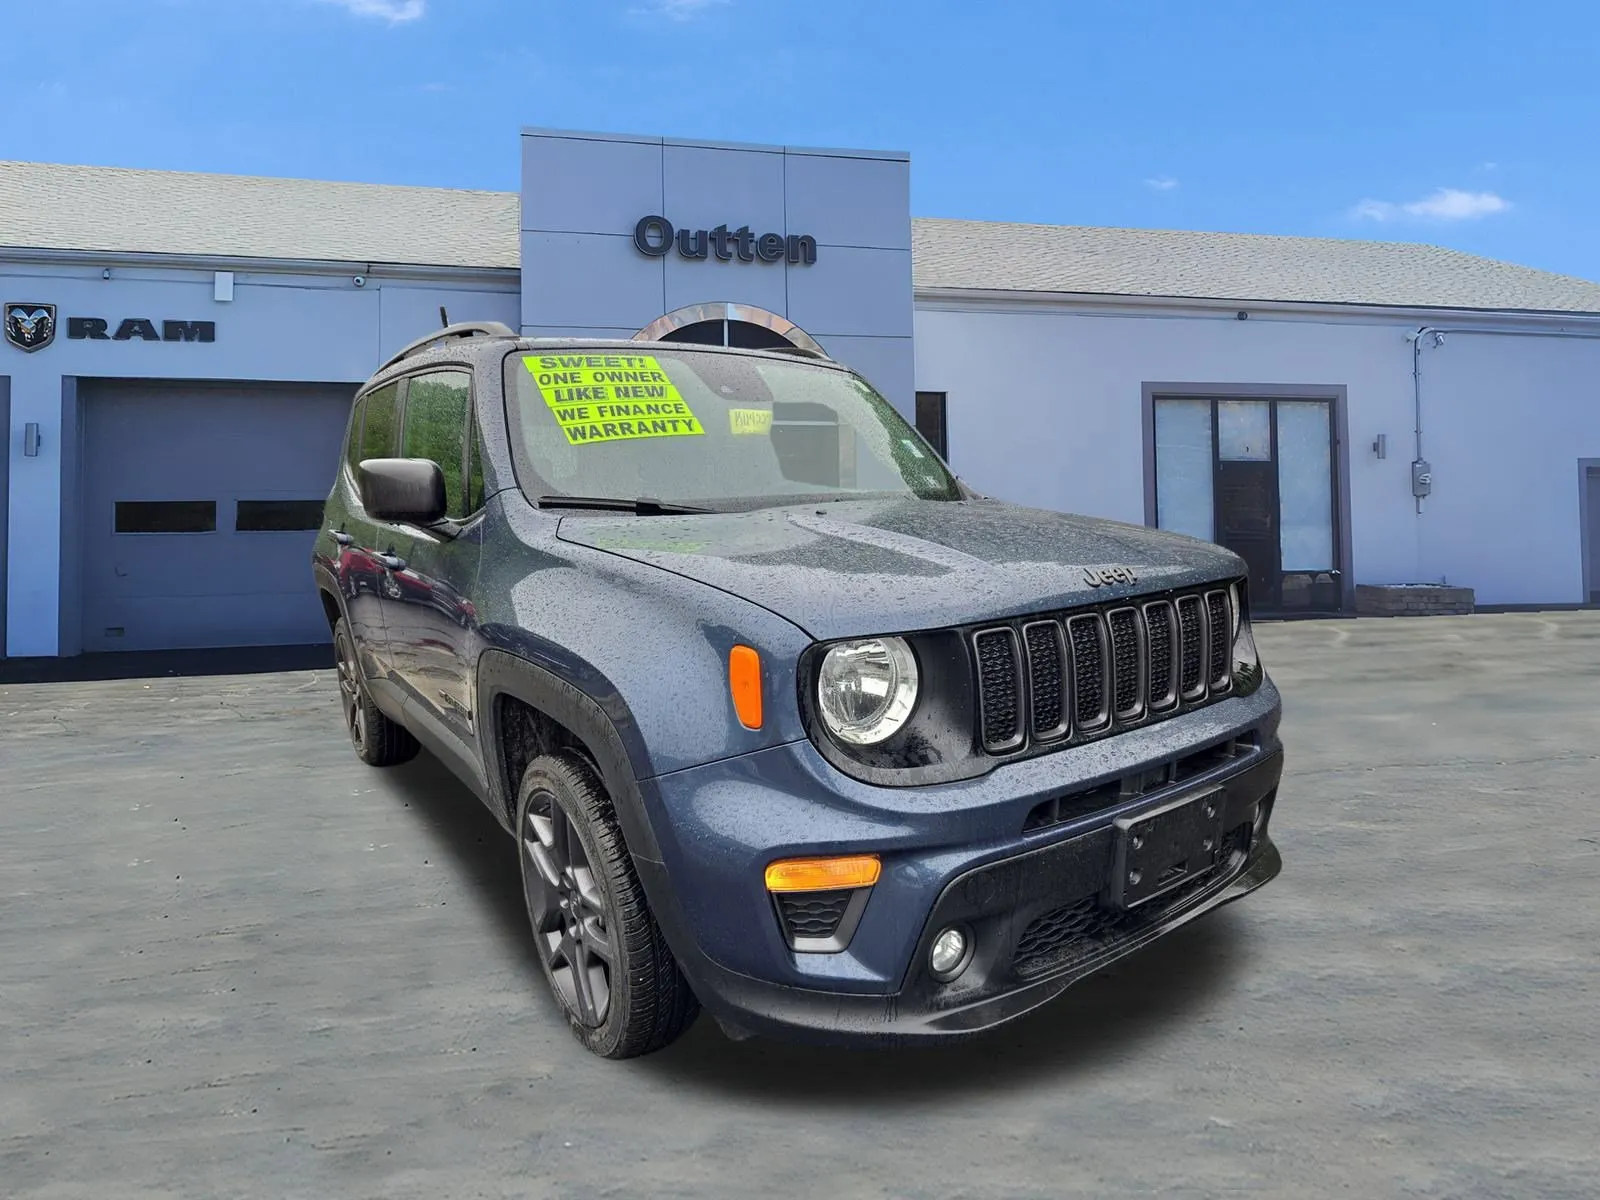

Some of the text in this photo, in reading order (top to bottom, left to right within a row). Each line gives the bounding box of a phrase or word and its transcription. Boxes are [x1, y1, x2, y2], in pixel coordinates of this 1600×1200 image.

[634, 215, 817, 264] Outten
[67, 317, 215, 342] RAM
[540, 356, 647, 369] SWEET!
[539, 371, 665, 386] ONE OWNER
[554, 385, 667, 402] LIKE NEW
[557, 403, 686, 421] WE FINANCE
[566, 419, 695, 441] WARRANTY
[1083, 567, 1137, 588] Jeep
